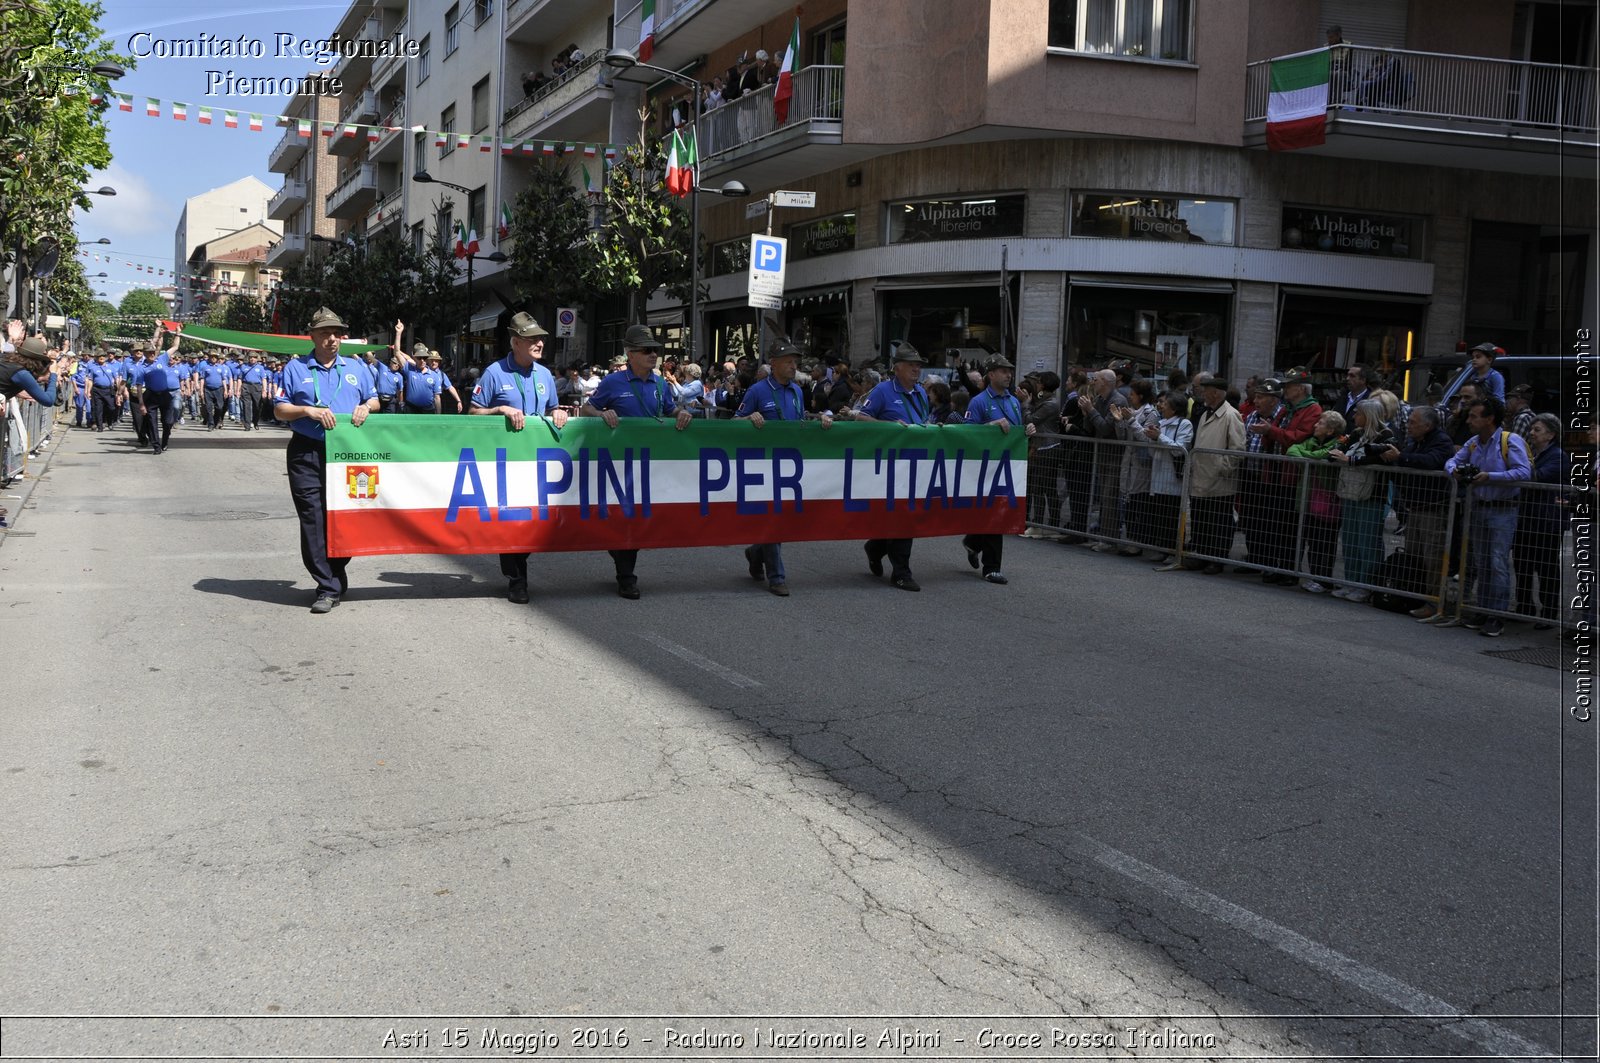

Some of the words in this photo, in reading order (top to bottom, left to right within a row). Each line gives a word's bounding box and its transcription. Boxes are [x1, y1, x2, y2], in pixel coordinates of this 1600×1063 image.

[917, 203, 997, 225] AlphaBeta
[805, 222, 848, 245] AlphaBeta
[940, 219, 982, 233] libreria
[1134, 218, 1184, 234] libreria
[1310, 215, 1396, 237] AlphaBeta
[1336, 233, 1381, 250] libreria
[760, 244, 777, 267] P
[334, 452, 392, 461] PORDENONE
[445, 447, 652, 523] ALPINI
[699, 447, 805, 517] PER
[842, 447, 1018, 512] L'ITALIA
